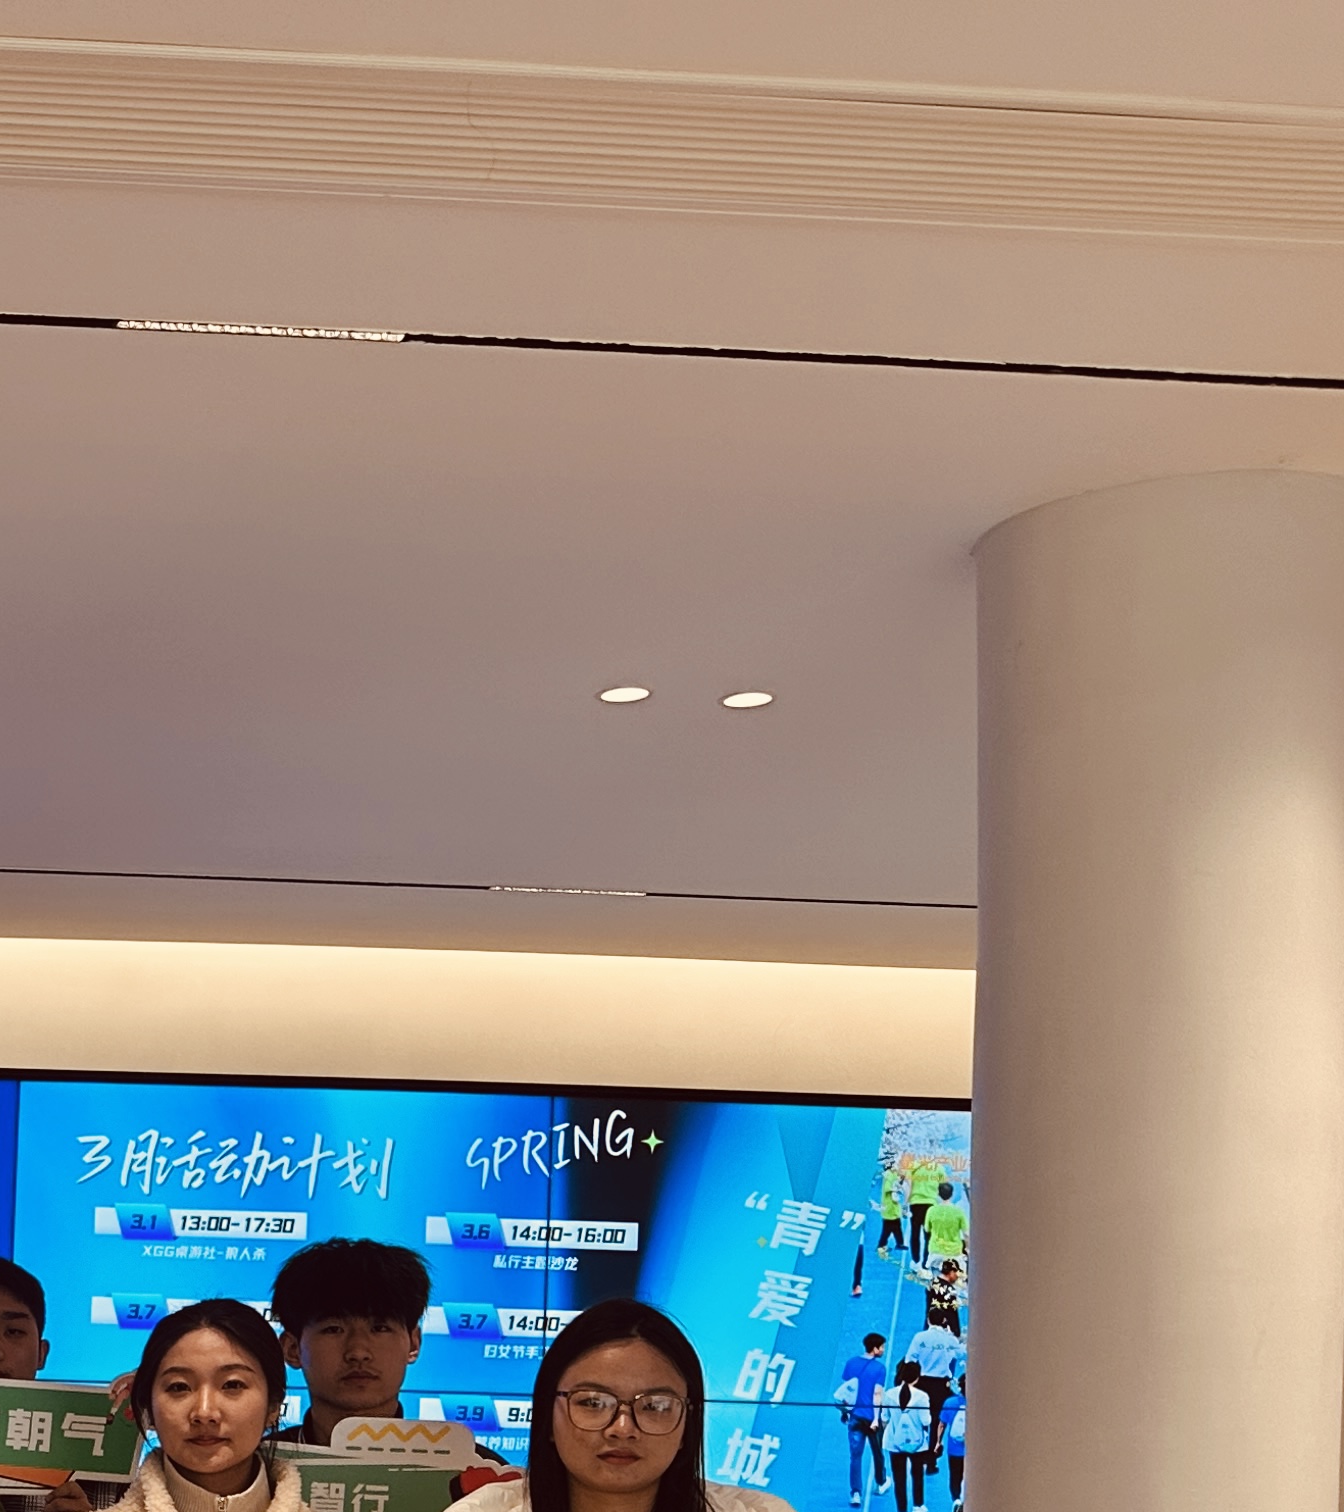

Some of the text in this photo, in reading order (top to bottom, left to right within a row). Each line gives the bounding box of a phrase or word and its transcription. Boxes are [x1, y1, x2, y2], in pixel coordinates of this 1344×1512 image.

[465, 1109, 635, 1190] SPRING
[129, 1213, 158, 1231] 3.1
[461, 1223, 491, 1241] 3.6
[126, 1302, 157, 1320] 3.7
[457, 1313, 489, 1331] 3.7
[454, 1405, 485, 1422] 3.9
